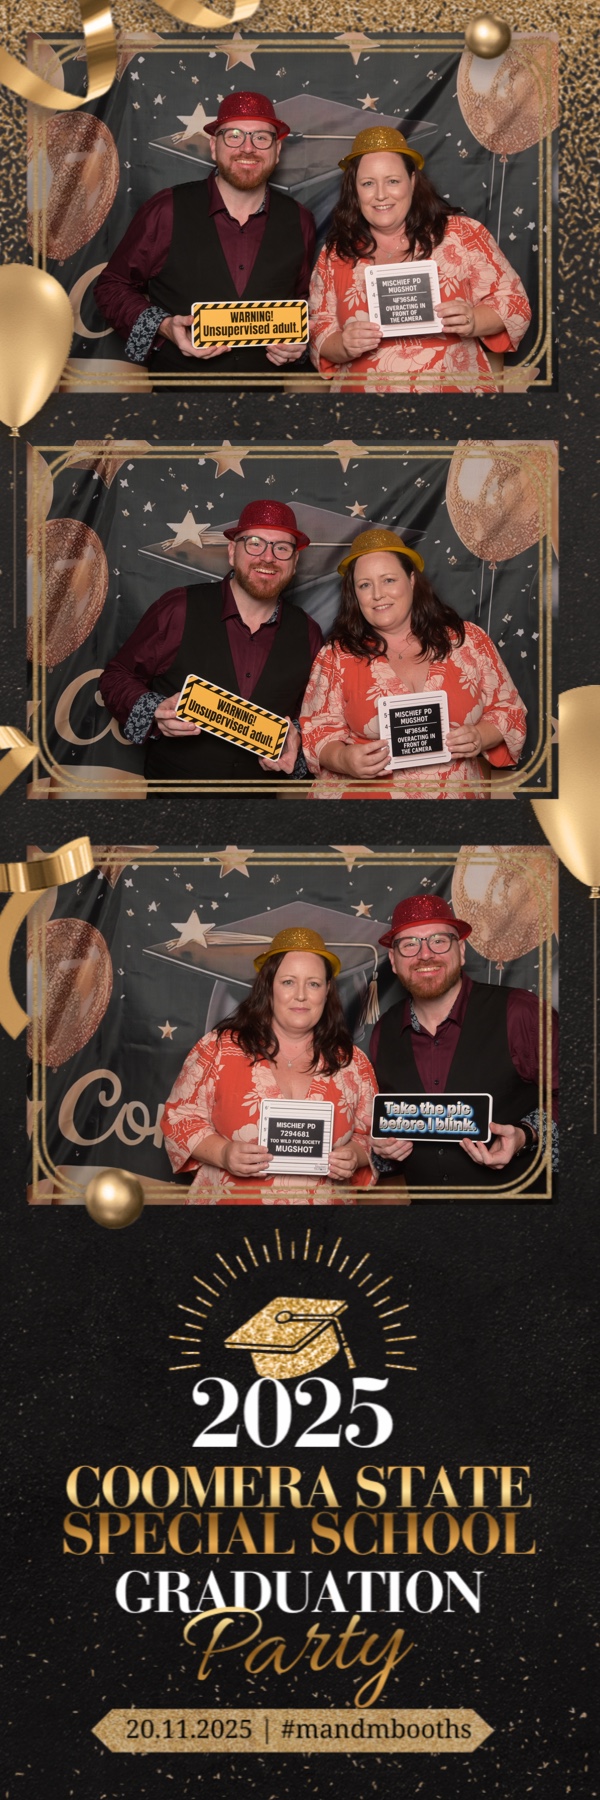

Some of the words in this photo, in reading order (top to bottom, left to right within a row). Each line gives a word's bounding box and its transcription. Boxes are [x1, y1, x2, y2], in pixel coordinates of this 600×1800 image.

[382, 279, 411, 287] MISCHIEF
[388, 285, 417, 294] MUGSHOT
[385, 303, 419, 312] OVERACTING
[230, 310, 274, 323] WARNING!
[203, 323, 270, 338] Unsupervised
[272, 322, 299, 334] adult.
[217, 698, 257, 727] WARNING!
[394, 709, 422, 718] MISCHIEF
[188, 698, 250, 737] Unsupervised
[249, 729, 274, 749] adult.
[400, 715, 428, 725] MUGSHOT
[397, 733, 429, 743] OVERACTING
[411, 746, 432, 754] CAMERA
[384, 1101, 418, 1115] Take
[420, 1101, 445, 1115] the
[447, 1101, 472, 1118] pic
[276, 1121, 305, 1129] MISCHIEF
[379, 1116, 426, 1131] before
[427, 1117, 433, 1131] I
[435, 1117, 478, 1132] blink.
[280, 1130, 310, 1138] 7294681
[275, 1145, 314, 1153] MUGSHOT
